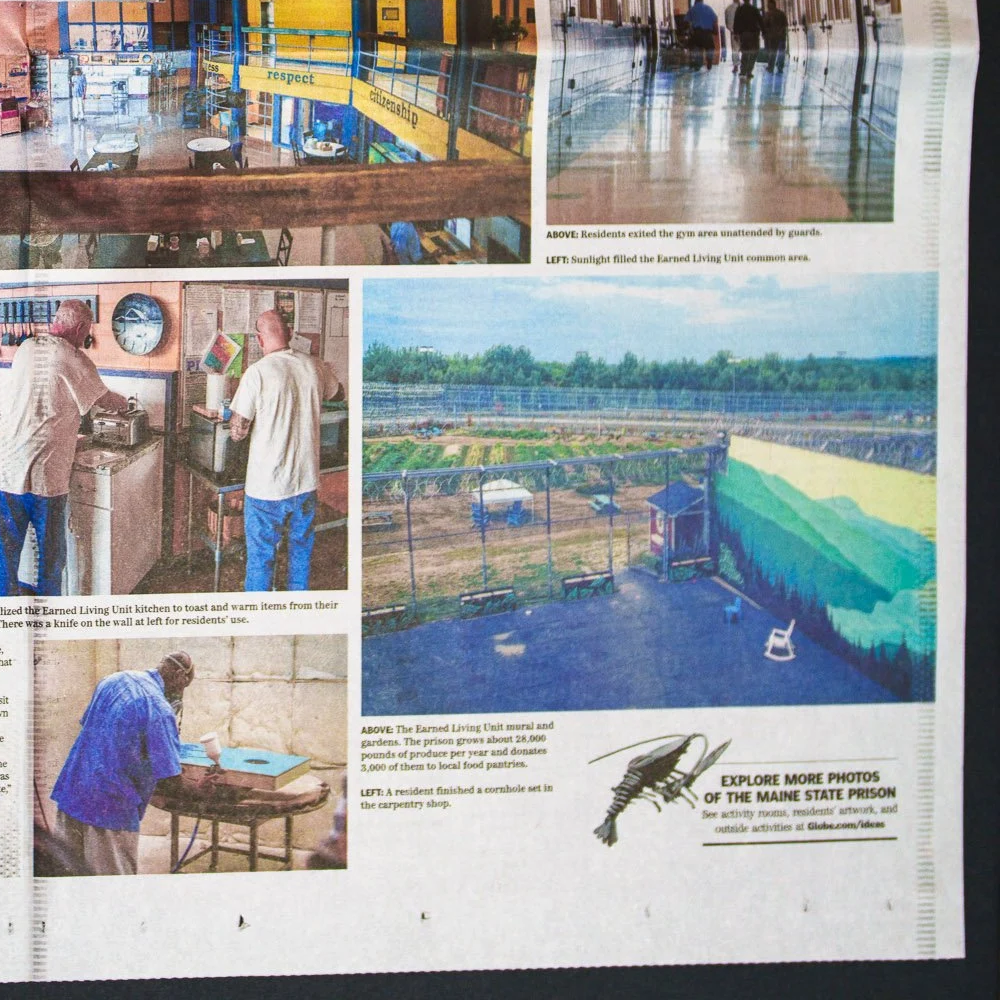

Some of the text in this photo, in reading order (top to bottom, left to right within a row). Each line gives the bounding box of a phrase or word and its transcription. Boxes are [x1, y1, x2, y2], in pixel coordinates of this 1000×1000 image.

[267, 70, 315, 85] respect
[369, 87, 419, 129] citizenship
[546, 230, 578, 239] ABOVE:
[580, 230, 626, 238] Residents
[628, 229, 656, 238] exited
[658, 229, 674, 237] the
[675, 230, 695, 239] gym
[720, 228, 773, 237] unattended
[775, 228, 785, 237] by
[788, 228, 822, 238] guards.
[24, 605, 40, 615] the
[42, 605, 77, 615] Earned
[79, 605, 109, 616] Living
[111, 604, 132, 614] Unit
[134, 604, 170, 613] kitchen
[172, 604, 182, 612] to
[184, 603, 208, 612] toast
[210, 602, 228, 611] and
[260, 601, 287, 610] items
[289, 601, 312, 610] from
[314, 600, 338, 609] their
[360, 721, 554, 734] ABOVE: The Earned Living Unit mural and
[720, 770, 880, 787] EXPLORE MORE PHOTOS
[360, 788, 384, 797] LEFT:
[385, 787, 392, 796] A
[394, 786, 434, 796] resident
[436, 785, 474, 795] finished
[484, 784, 526, 793] cornhole
[527, 784, 541, 792] set
[543, 783, 553, 792] in
[704, 786, 896, 804] OF THE MAINE STATE PRISON
